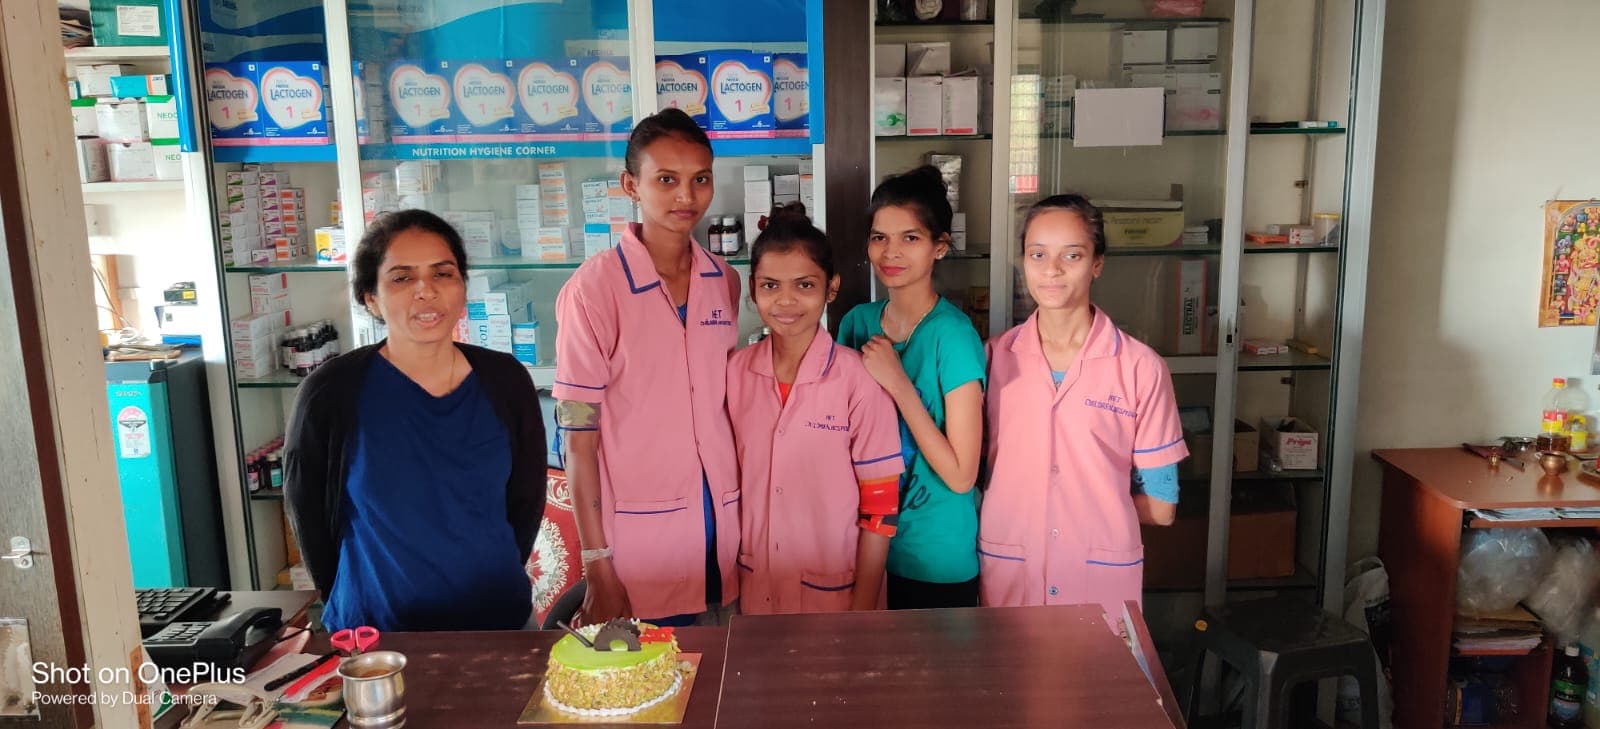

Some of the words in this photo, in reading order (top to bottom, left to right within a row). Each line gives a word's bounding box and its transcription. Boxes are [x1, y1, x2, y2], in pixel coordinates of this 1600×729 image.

[398, 86, 441, 99] LACTOGEN
[463, 85, 505, 98] LACTOGEN
[527, 83, 569, 97] LACTOGEN
[656, 82, 698, 95] LACTOGEN
[720, 82, 762, 95] LACTOGEN
[773, 81, 809, 93] ACTOGEN
[270, 88, 312, 101] LACTOGEN
[414, 103, 421, 116] 1
[479, 102, 485, 115] 1
[542, 100, 549, 114] 1
[607, 100, 613, 113] 1
[735, 98, 743, 113] 1
[784, 97, 791, 112] 1
[222, 106, 230, 119] 1
[286, 105, 294, 119] 1
[411, 147, 466, 158] NUTRITION
[469, 146, 513, 156] HYGIENE
[515, 146, 556, 156] CORNER
